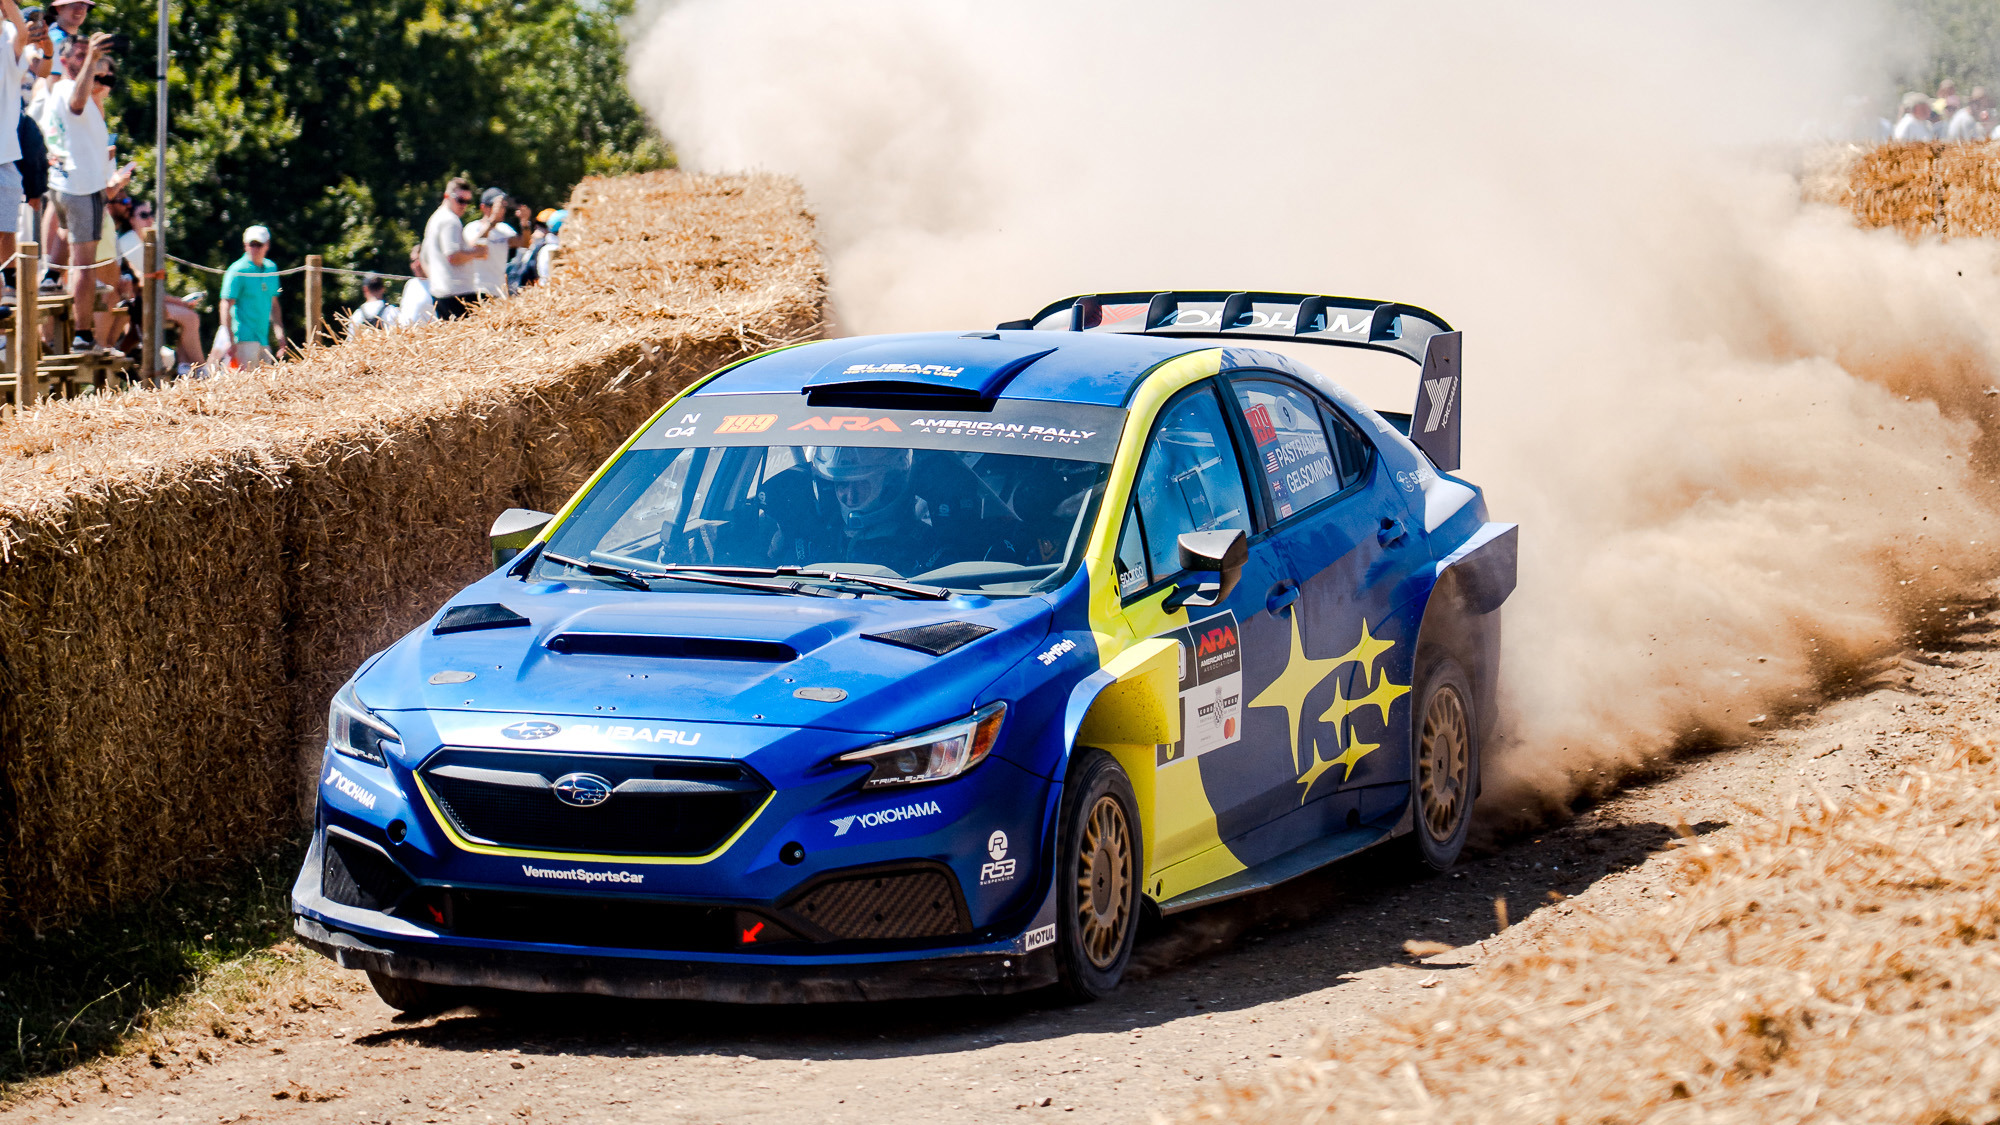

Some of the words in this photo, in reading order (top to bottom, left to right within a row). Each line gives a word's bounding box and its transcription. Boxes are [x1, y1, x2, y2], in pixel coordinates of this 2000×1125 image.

[847, 364, 964, 373] SUBARU
[664, 427, 695, 438] 04
[680, 413, 701, 424] N
[713, 414, 779, 433] 199
[787, 416, 902, 432] ARA
[910, 418, 1024, 433] AMERICAN
[1028, 425, 1096, 439] RALLY
[1243, 403, 1277, 447] 199
[1287, 456, 1333, 493] GELSOMINO
[1198, 626, 1237, 657] ARA
[1201, 654, 1223, 667] AMERICAN
[1223, 649, 1236, 660] RALLY
[568, 725, 701, 746] SUBARU
[335, 774, 376, 810] YOKOHAMA
[856, 801, 941, 828] YOKOHAMA
[522, 865, 644, 883] VermontSportsCar
[980, 876, 1014, 885] SUSPENSION
[1028, 927, 1054, 946] MOTUL
